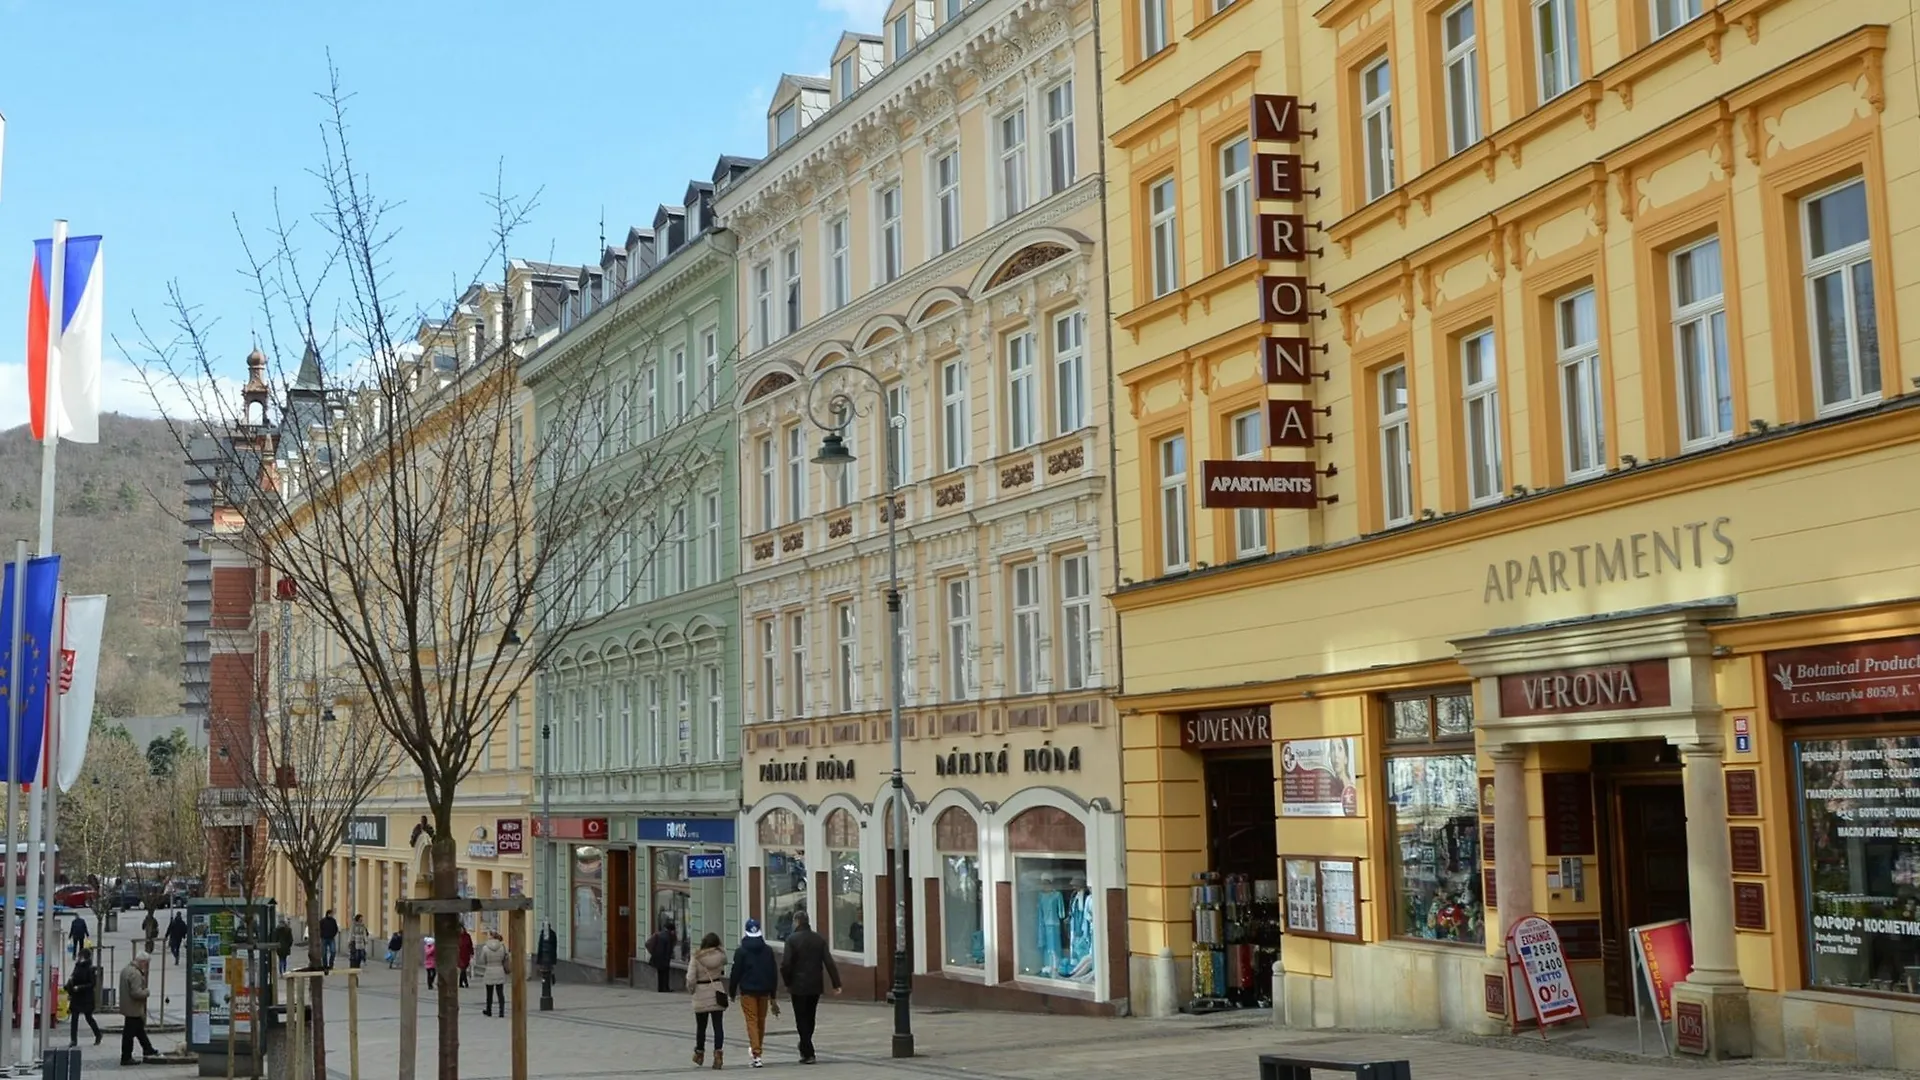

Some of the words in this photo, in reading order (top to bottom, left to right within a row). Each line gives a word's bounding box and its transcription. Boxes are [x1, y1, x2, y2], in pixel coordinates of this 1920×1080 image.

[1265, 100, 1307, 440] VERONA
[1210, 476, 1312, 493] APARTMENTS
[1484, 516, 1735, 603] APARTMENTS
[1797, 659, 1860, 679] Botanical
[1522, 669, 1638, 709] VERONA
[1790, 692, 1800, 704] T.
[1815, 688, 1864, 702] Masaryka
[1866, 685, 1899, 699] 805/9,
[1187, 708, 1270, 743] SUVENÝR
[1889, 768, 1920, 778] COLLAG
[347, 822, 378, 841] SPHORA
[689, 858, 722, 869] FOKUS
[1813, 915, 1856, 931] ФАРФОР
[1863, 918, 1920, 937] КОСМЕТИК
[1521, 930, 1551, 946] EXCHANGE
[1533, 941, 1558, 957] 2690
[1538, 957, 1562, 972] 2400
[1536, 970, 1562, 984] NETTO
[1538, 982, 1569, 1002] 0%
[1679, 1015, 1702, 1036] 0%
